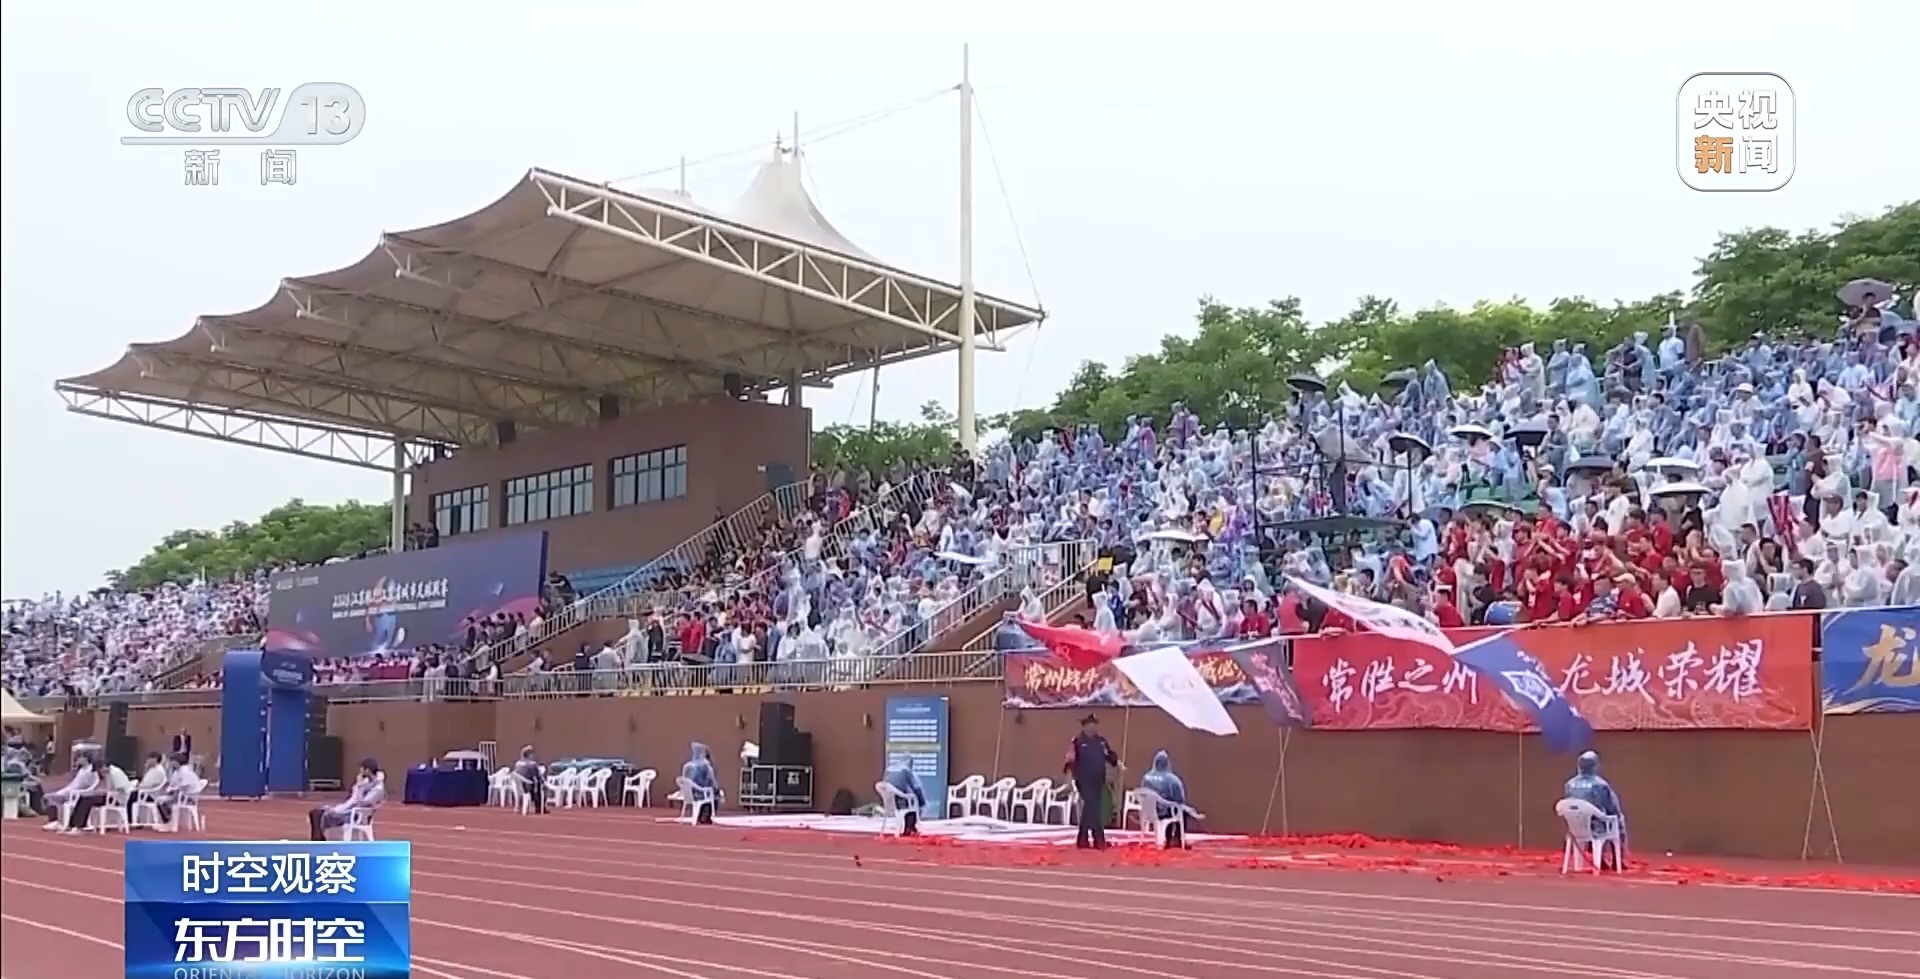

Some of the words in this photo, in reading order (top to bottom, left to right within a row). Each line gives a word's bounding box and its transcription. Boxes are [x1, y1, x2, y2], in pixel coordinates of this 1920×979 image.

[1322, 655, 1478, 714] 常胜之州
[1560, 638, 1764, 704] 龙城荣耀
